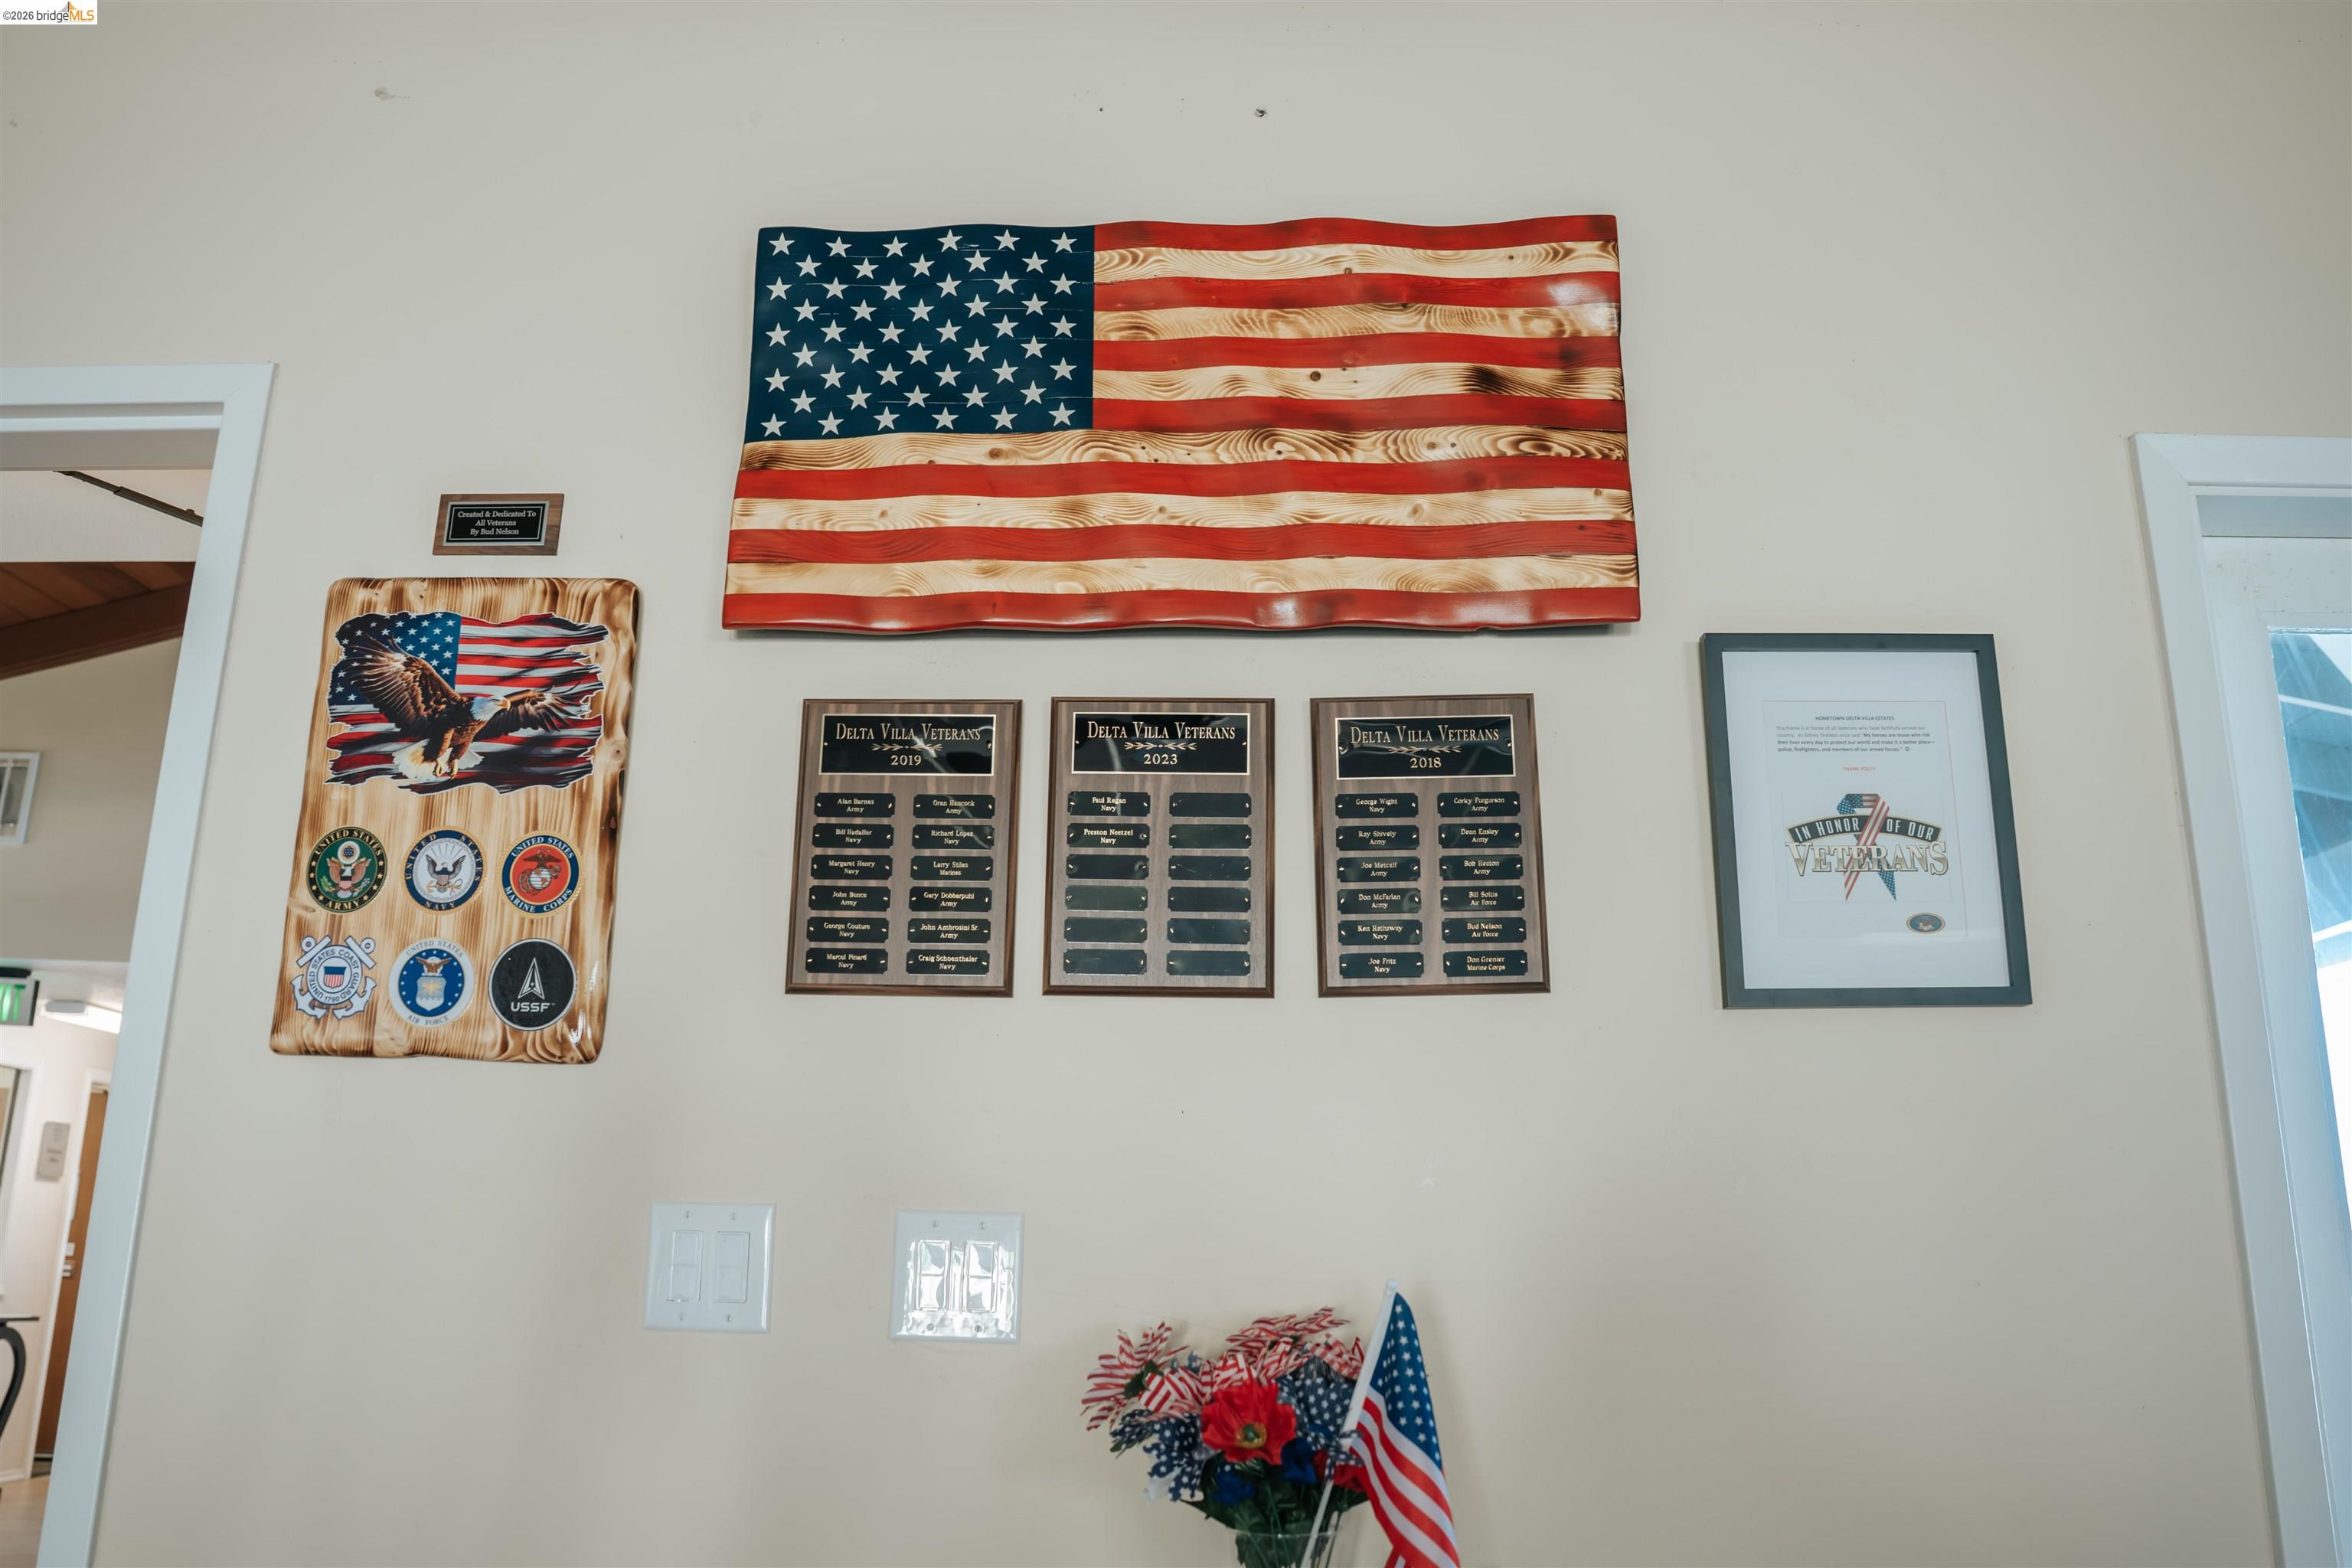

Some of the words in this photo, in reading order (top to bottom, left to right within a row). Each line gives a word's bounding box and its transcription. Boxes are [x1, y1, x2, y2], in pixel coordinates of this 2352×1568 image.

[470, 528, 479, 537] By
[835, 723, 874, 740] DELTA
[880, 723, 916, 740] VILLA
[921, 724, 981, 740] VETERANS
[1087, 720, 1128, 738] DELTA
[1132, 721, 1170, 739] VILLA
[1174, 721, 1236, 740] VETERANS
[1350, 726, 1391, 743] DELTA
[1396, 725, 1432, 743] VILLA
[1437, 724, 1499, 741] VETERANS
[890, 755, 922, 766] 2019
[1143, 753, 1178, 765] 2023
[1410, 757, 1442, 769] 2018
[1795, 825, 1811, 842] IN
[1815, 817, 1860, 838] HONOR
[1886, 818, 1901, 833] OF
[1908, 822, 1934, 841] OUR
[315, 830, 349, 855] UNITED
[353, 830, 382, 856] STATES
[511, 837, 544, 858] UNITED
[547, 837, 574, 858] STATES
[405, 834, 436, 880] UNITED
[459, 835, 482, 881] STATES
[1785, 841, 1949, 877] VETERANS
[326, 900, 359, 910] ARMY
[425, 901, 455, 910] NAVY
[505, 886, 535, 913] MARINE
[543, 889, 573, 911] CORPS
[405, 939, 434, 956] UNITED
[438, 940, 464, 957] STATES
[312, 949, 335, 969] STATES
[338, 949, 359, 969] COAST
[939, 962, 956, 971] Navy
[309, 971, 323, 999] UNITED
[340, 972, 359, 999] GUARD
[407, 1014, 420, 1024] AIR
[425, 1015, 449, 1026] FORCE
